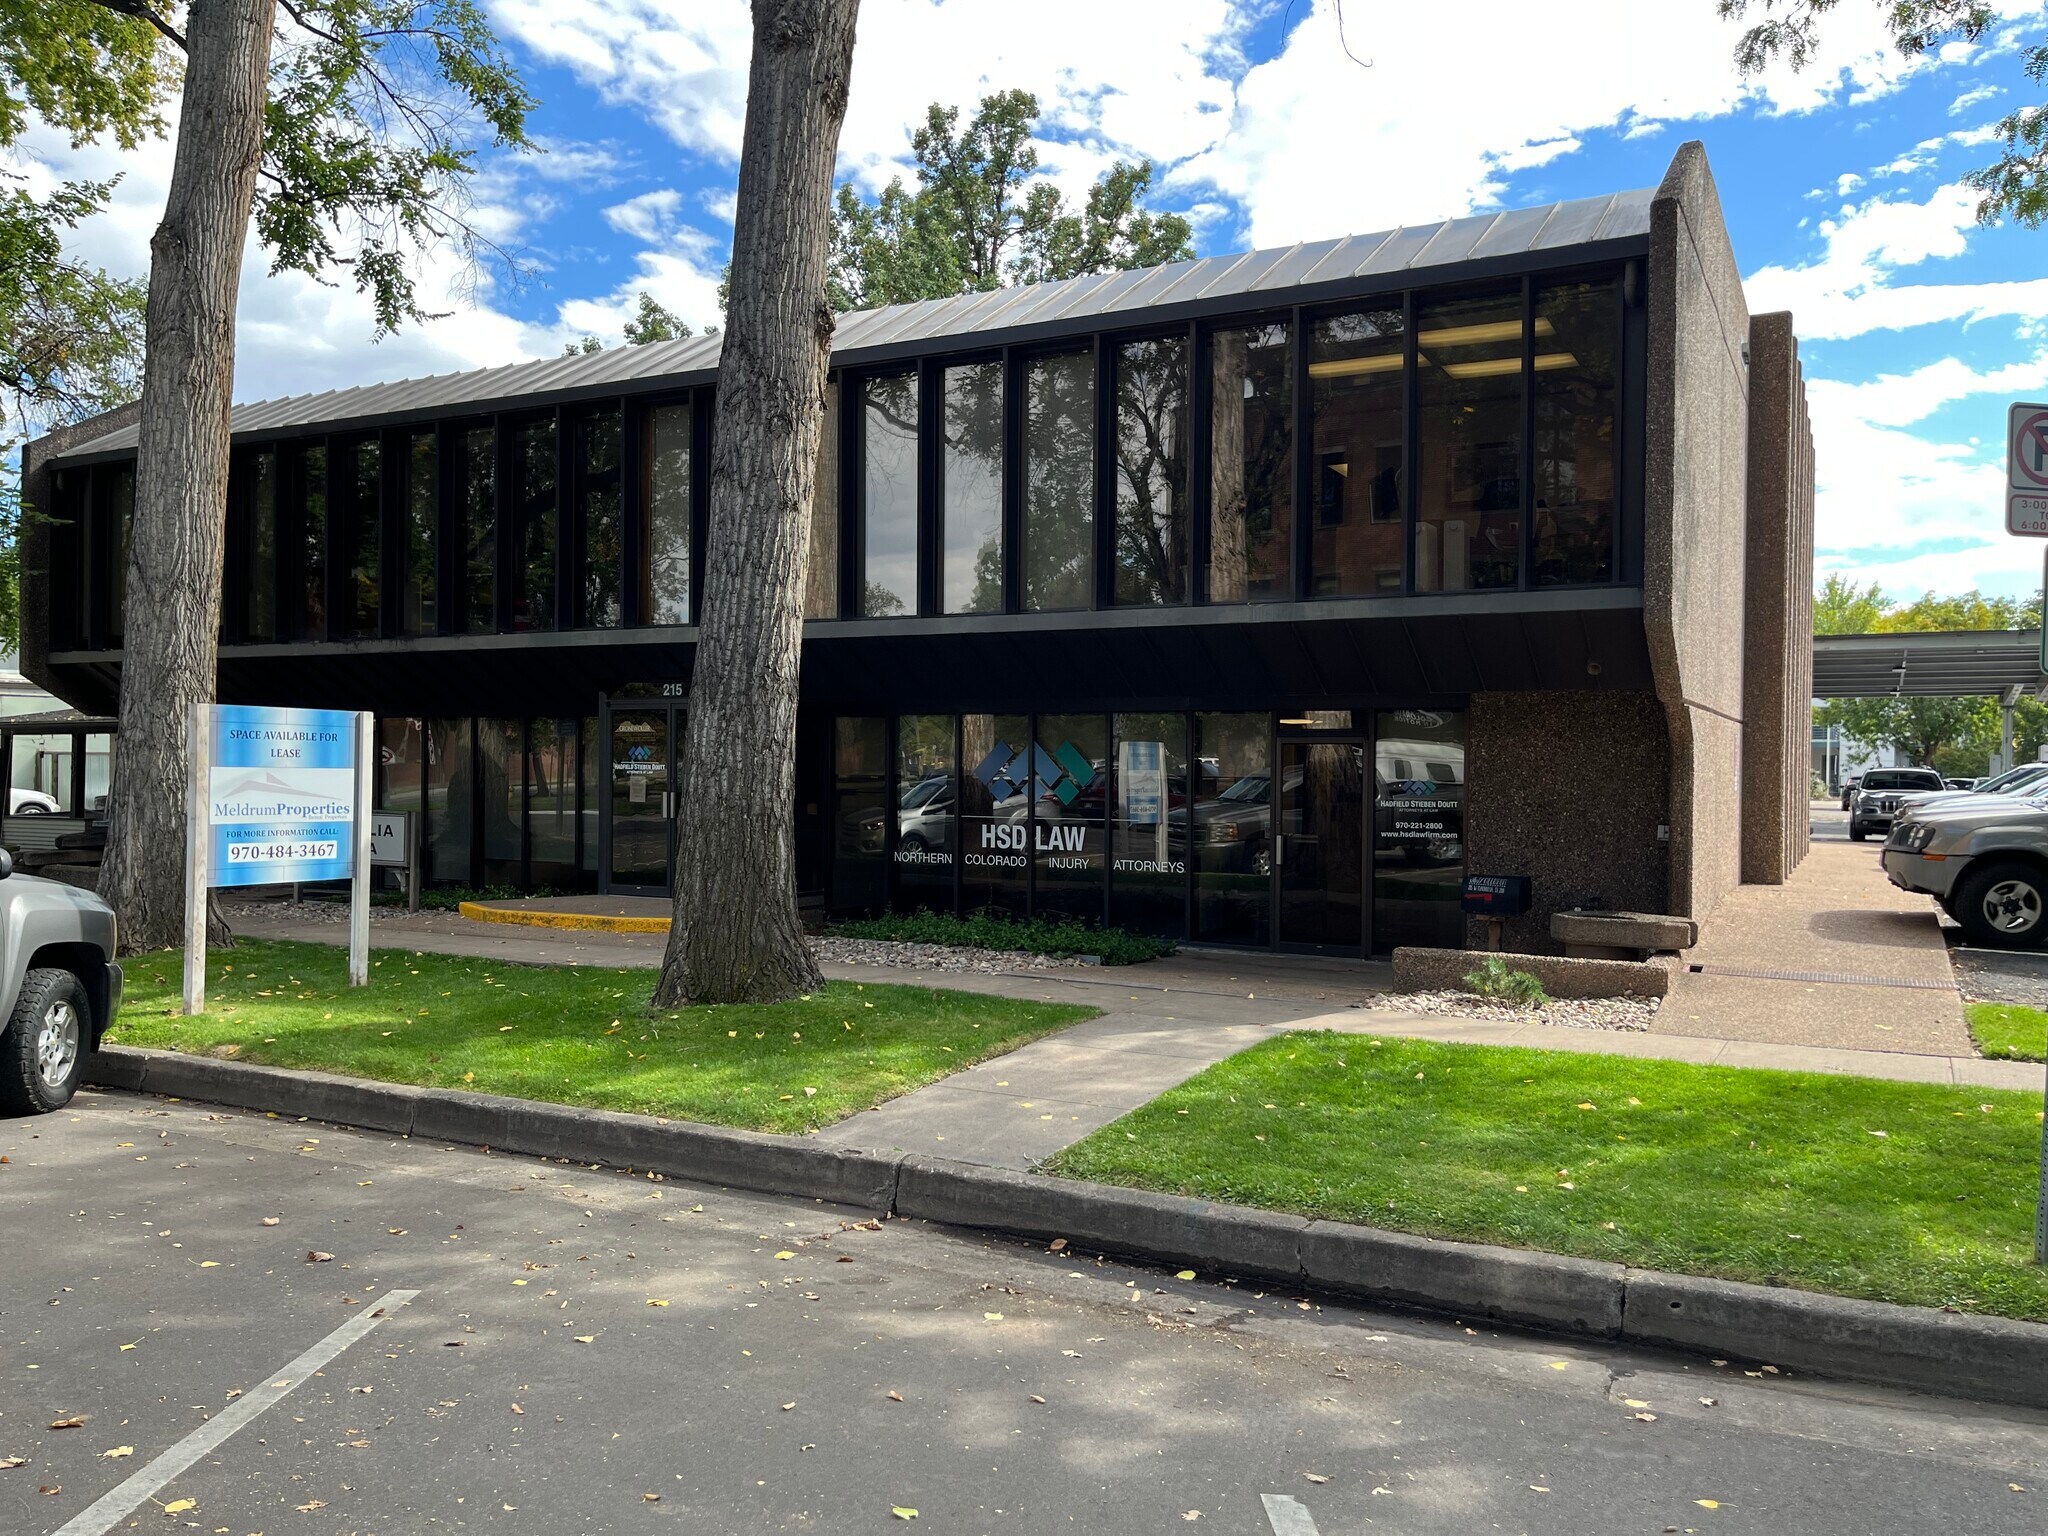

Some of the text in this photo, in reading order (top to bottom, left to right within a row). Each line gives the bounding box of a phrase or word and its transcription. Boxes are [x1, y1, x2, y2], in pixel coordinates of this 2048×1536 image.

[2021, 500, 2047, 509] 3:00
[2021, 521, 2047, 530] 6:00
[663, 683, 682, 696] 215
[230, 729, 338, 742] SPACE AVAILABLE FOR
[271, 748, 301, 758] LEASE
[1380, 800, 1410, 808] HADFIELD
[1410, 800, 1436, 808] STIEBEN
[1395, 821, 1443, 830] 970-221-2800
[243, 830, 266, 838] MORE
[267, 828, 318, 837] INFORMATION
[319, 828, 339, 836] CALL:
[981, 824, 1086, 852] HSD LAW
[1380, 830, 1458, 839] www.hsdlawfirm.com
[231, 843, 335, 860] 970-484-3467
[894, 851, 1185, 874] NORTHERN COLORADO INJURY ATTORNEYS
